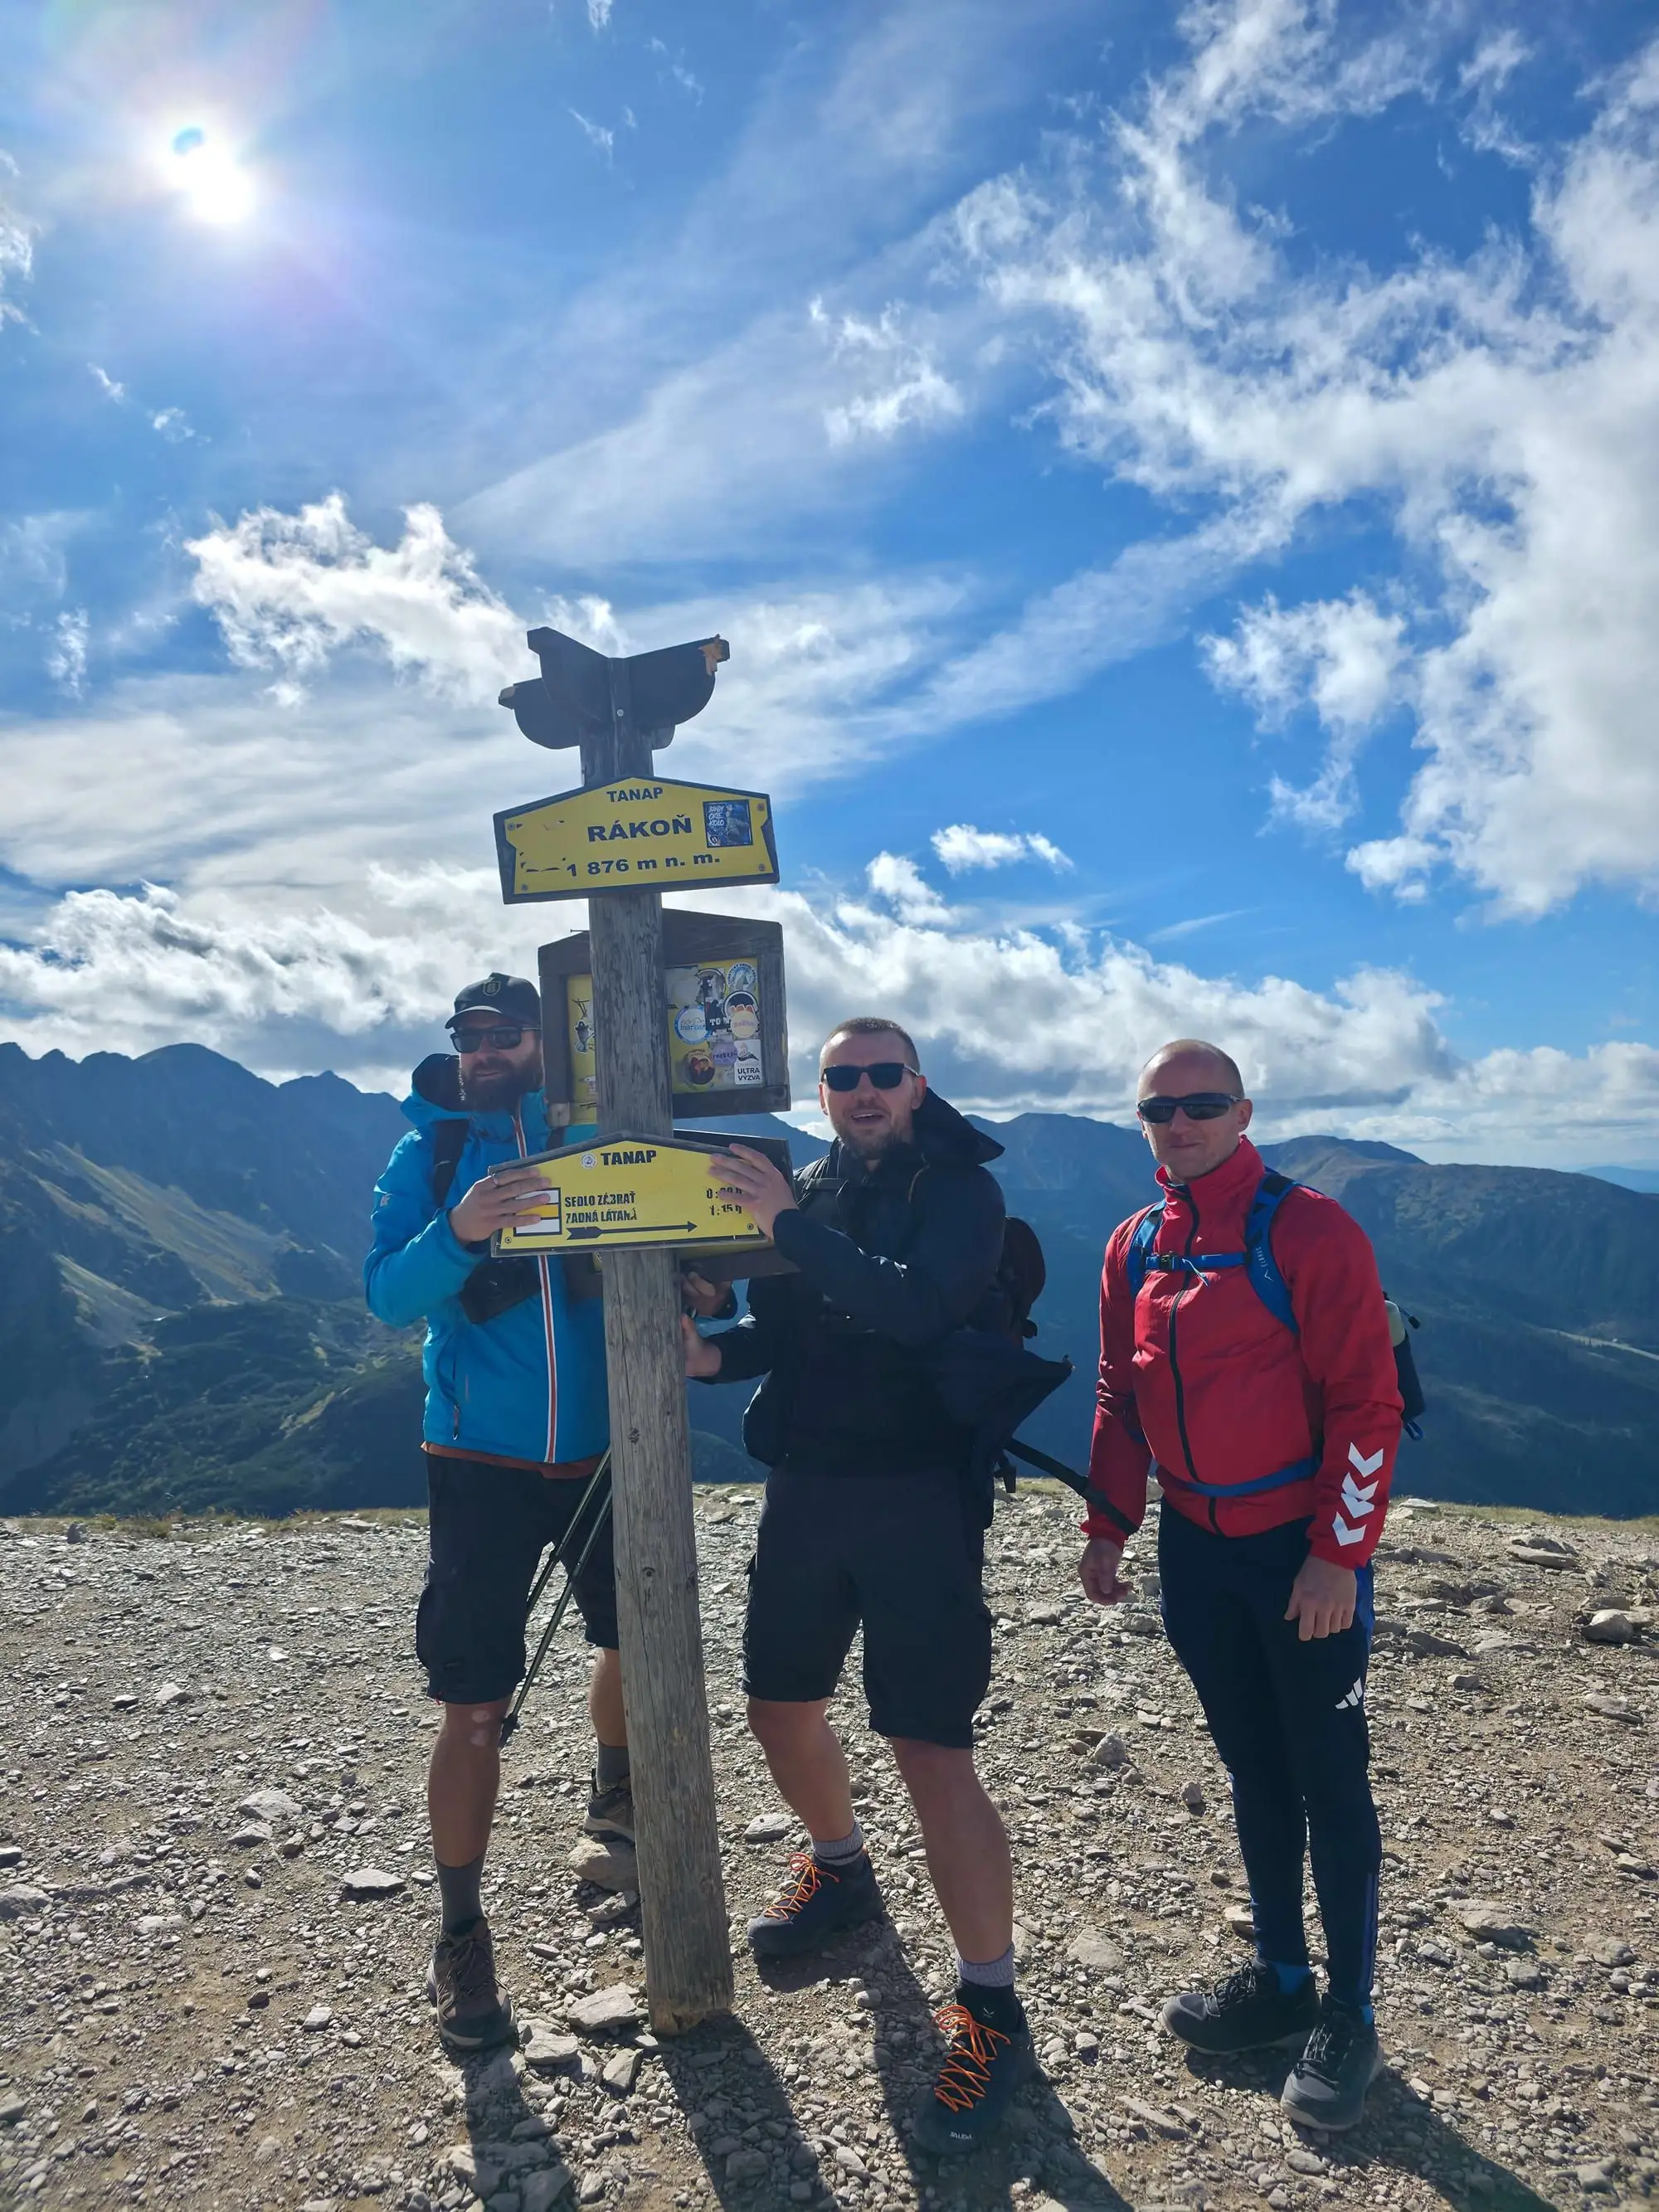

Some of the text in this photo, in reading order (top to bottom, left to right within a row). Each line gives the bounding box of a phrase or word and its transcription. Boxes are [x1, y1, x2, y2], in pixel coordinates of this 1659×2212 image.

[606, 787, 664, 803] TANAP
[587, 814, 693, 843] RÁKOŇ
[567, 853, 720, 877] 1 876 m n. m.
[737, 1067, 761, 1075] ULTRA
[737, 1073, 761, 1082] VÝZVA
[600, 1150, 657, 1166] TANAP
[565, 1195, 596, 1208] SEDLO
